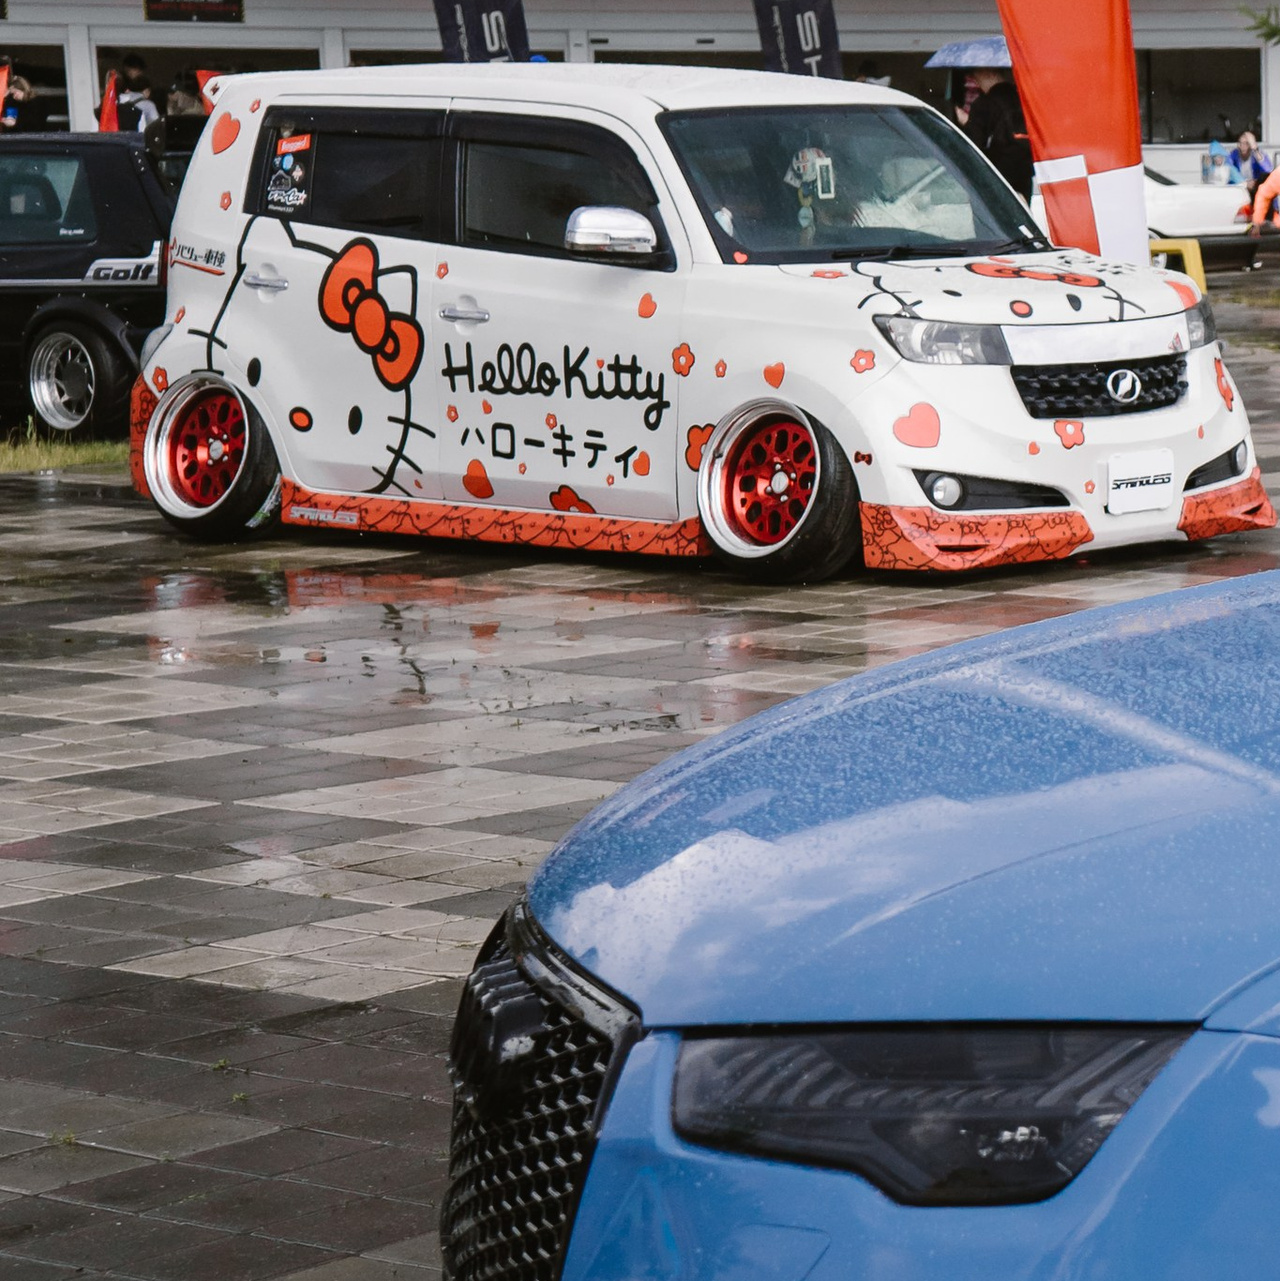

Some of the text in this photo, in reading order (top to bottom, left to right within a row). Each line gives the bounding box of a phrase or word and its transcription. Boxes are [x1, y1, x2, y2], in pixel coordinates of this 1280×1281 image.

[92, 263, 154, 281] Golf
[441, 341, 671, 431] Hello Kitty
[460, 422, 638, 478] ハローキティ
